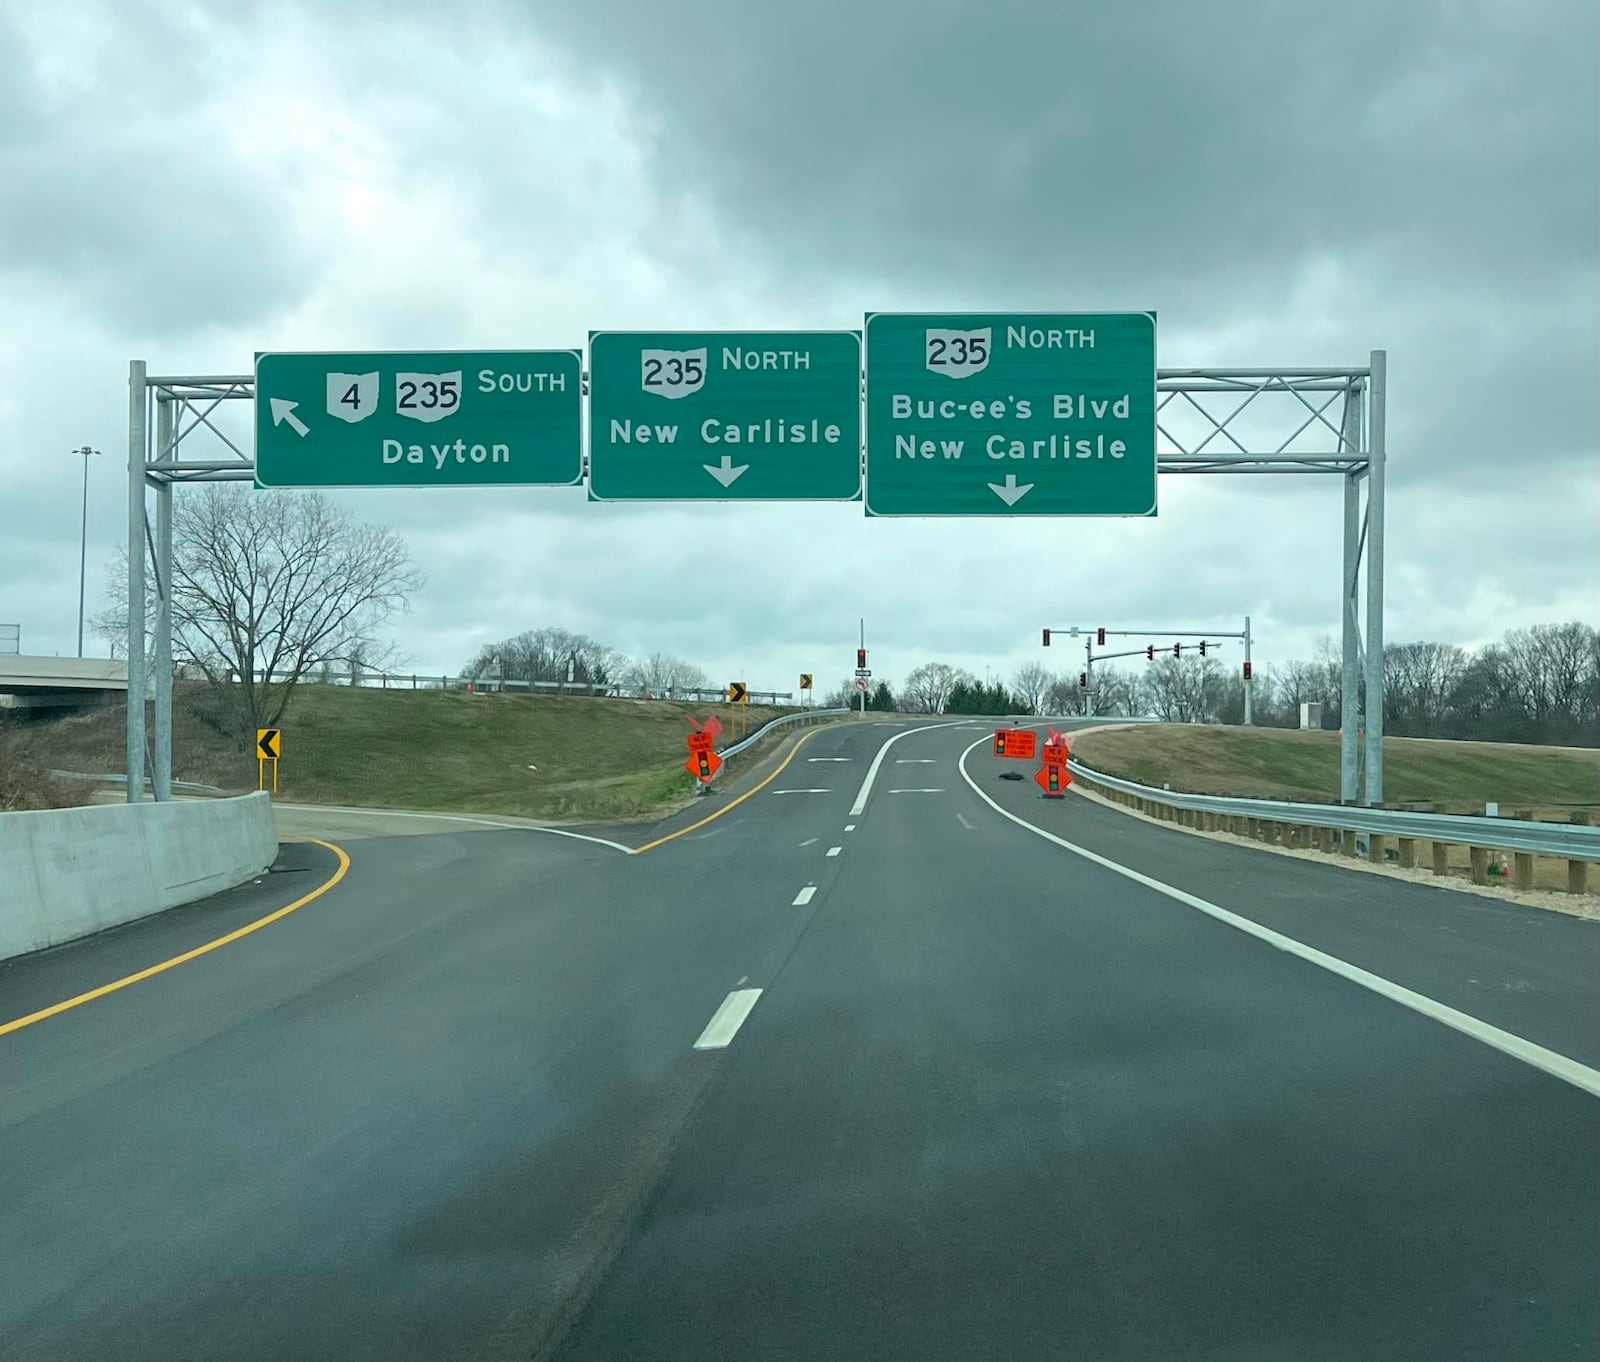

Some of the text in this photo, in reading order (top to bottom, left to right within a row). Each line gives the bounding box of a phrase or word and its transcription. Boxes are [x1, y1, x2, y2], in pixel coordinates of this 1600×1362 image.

[928, 326, 1095, 366] 235 NORTH
[644, 347, 810, 386] 235 NORTH
[340, 370, 565, 410] 4 235 SOUTH
[892, 395, 1130, 419] Buc-ee's Blvd
[610, 419, 841, 444] New Carlisle
[382, 439, 510, 470] Dayton
[895, 435, 1126, 460] New Carlisle
